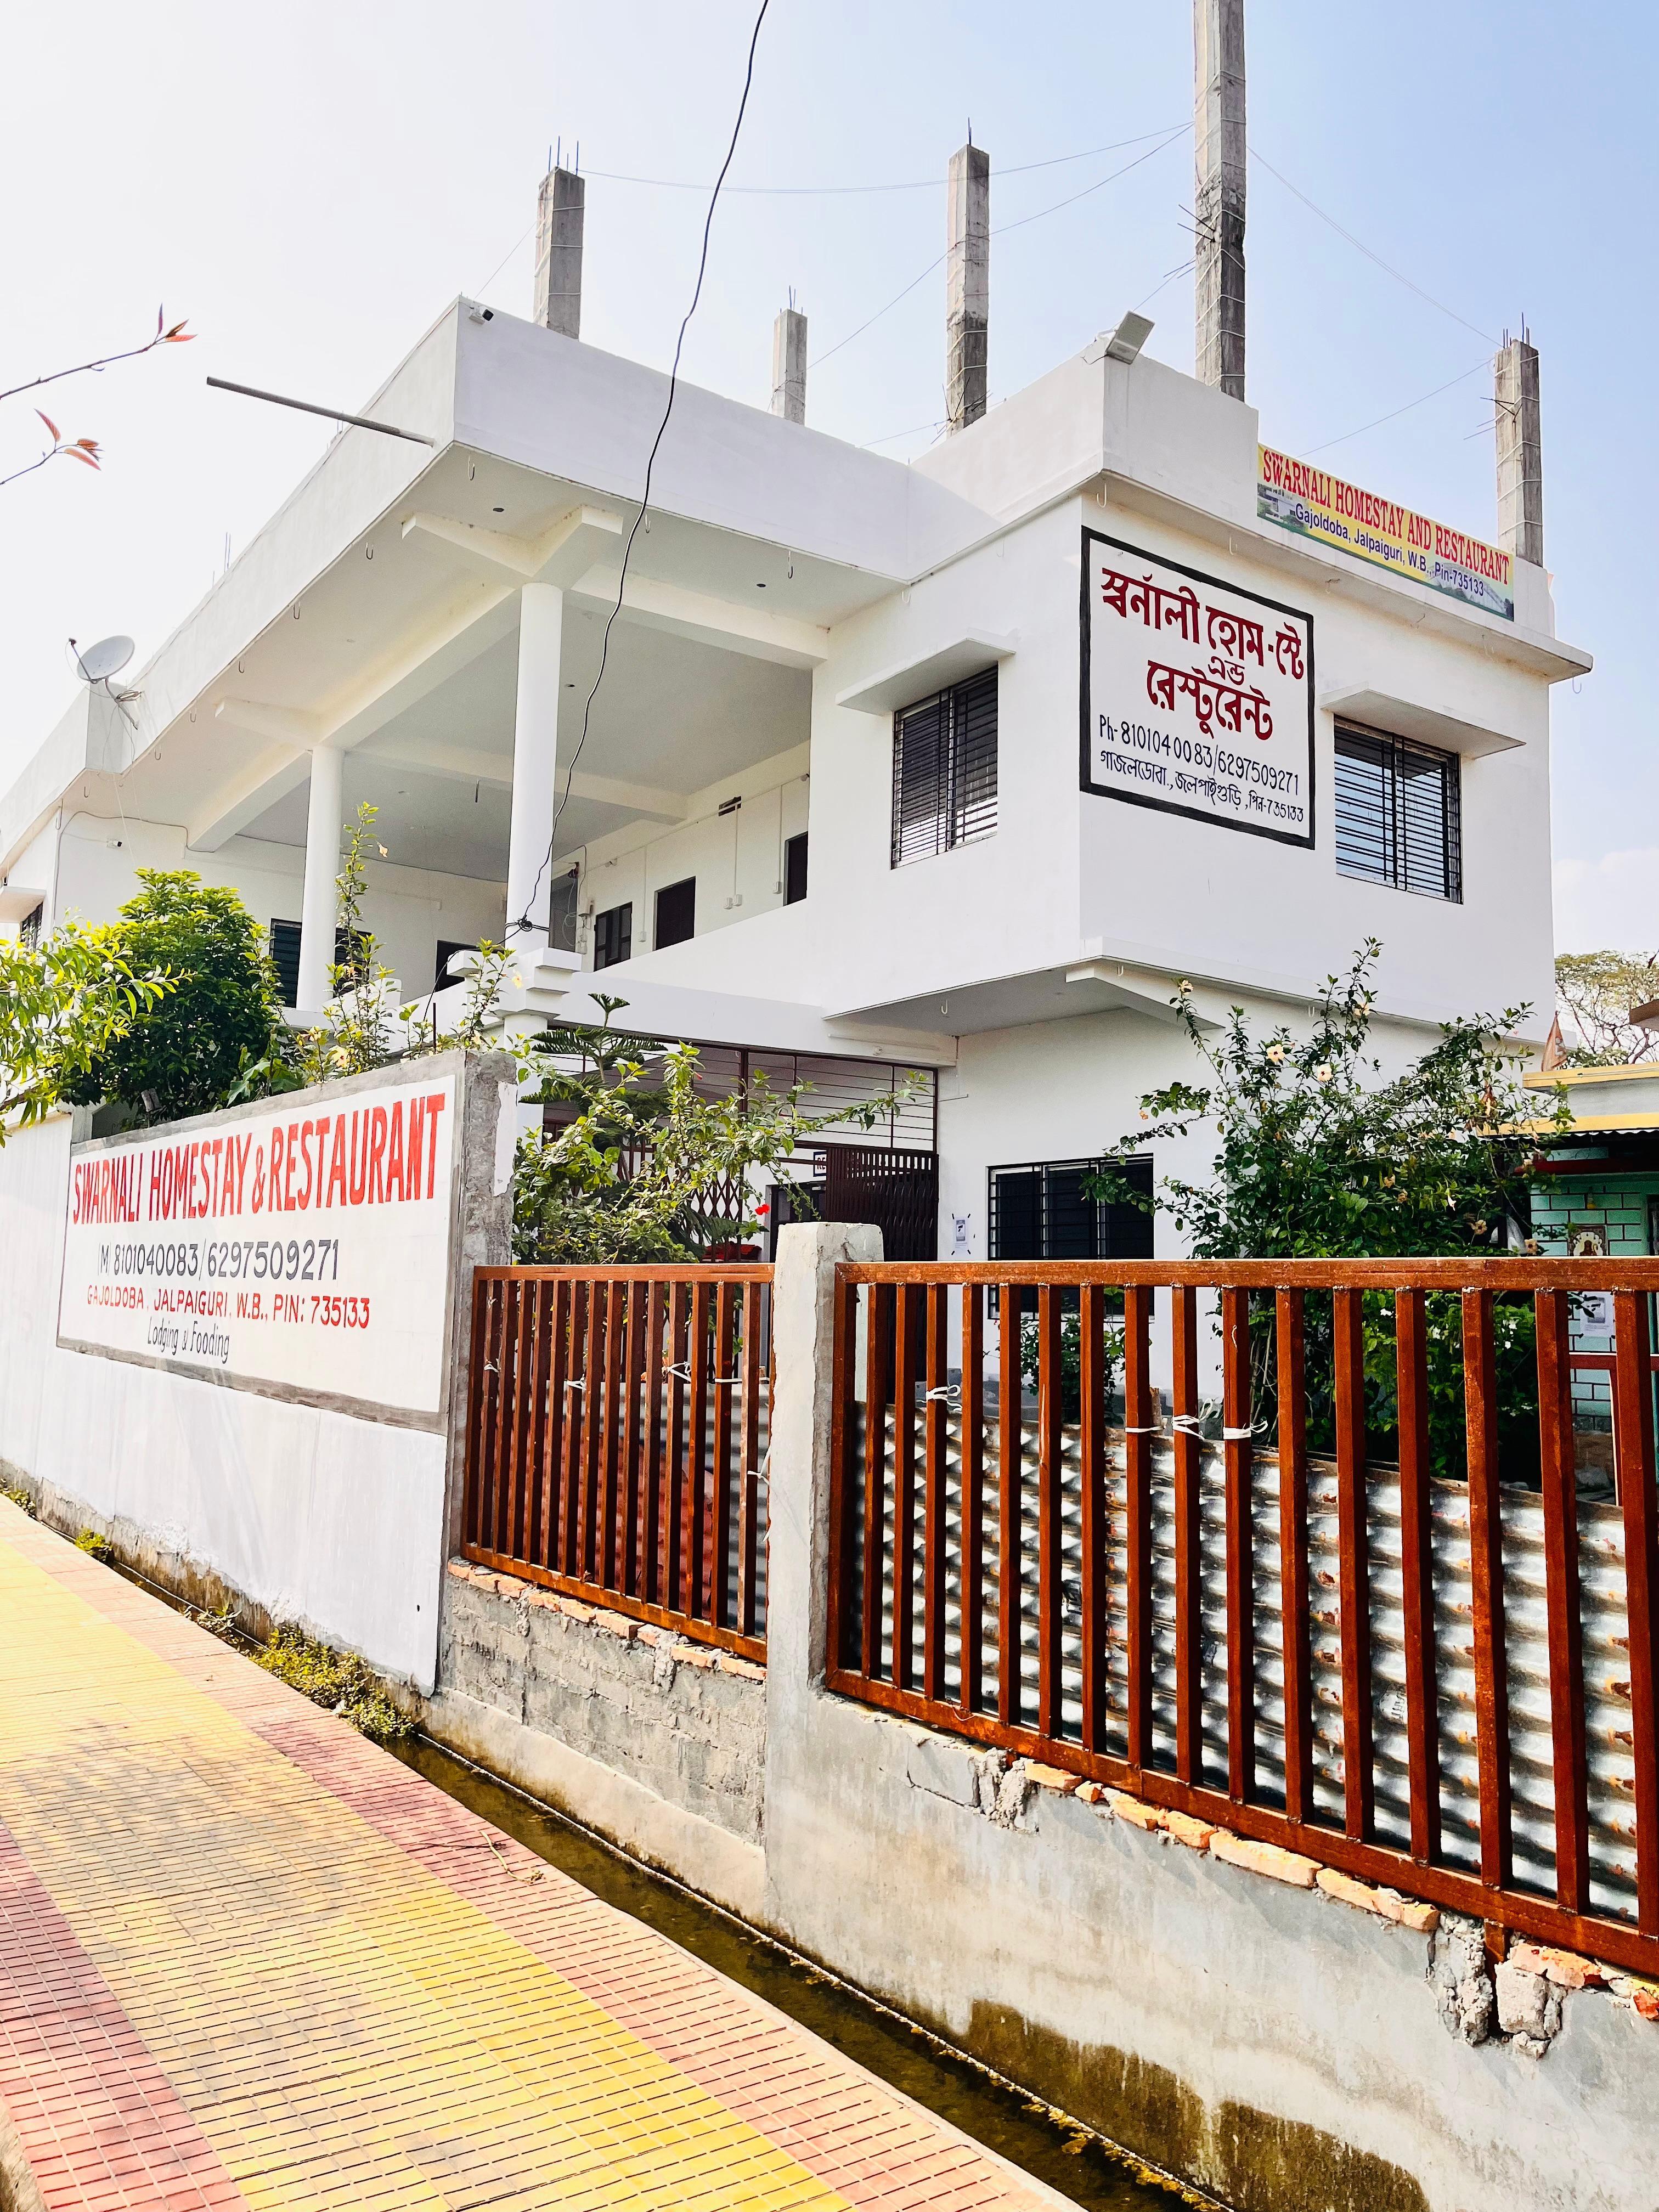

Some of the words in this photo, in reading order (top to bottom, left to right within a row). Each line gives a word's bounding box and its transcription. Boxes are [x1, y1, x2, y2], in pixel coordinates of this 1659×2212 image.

[1263, 449, 1331, 509] SWARNALI
[1335, 479, 1404, 539] HOMESTAY
[1407, 513, 1431, 551] AND
[1435, 524, 1509, 585] RESTAURANT
[1295, 503, 1351, 544] Gajoldoba,
[1354, 528, 1406, 566] Jalpaiguri,
[1435, 561, 1484, 597] Pin-735133
[1101, 567, 1200, 645] স্বর্নালী
[1147, 659, 1273, 741] রেস্টুরেন্ট
[1208, 656, 1245, 685] এন্ড
[73, 1152, 143, 1225] SWARNALI
[149, 1132, 253, 1222] HOMESTAY
[252, 1144, 266, 1214] &
[268, 1092, 445, 1212] RESTAURANT
[148, 1316, 179, 1356] Lodging
[182, 1327, 189, 1351] &
[190, 1320, 229, 1364] Fooding
[237, 1292, 268, 1323] W.B.,
[273, 1293, 305, 1323] PIN:
[311, 1295, 370, 1329] 735133
